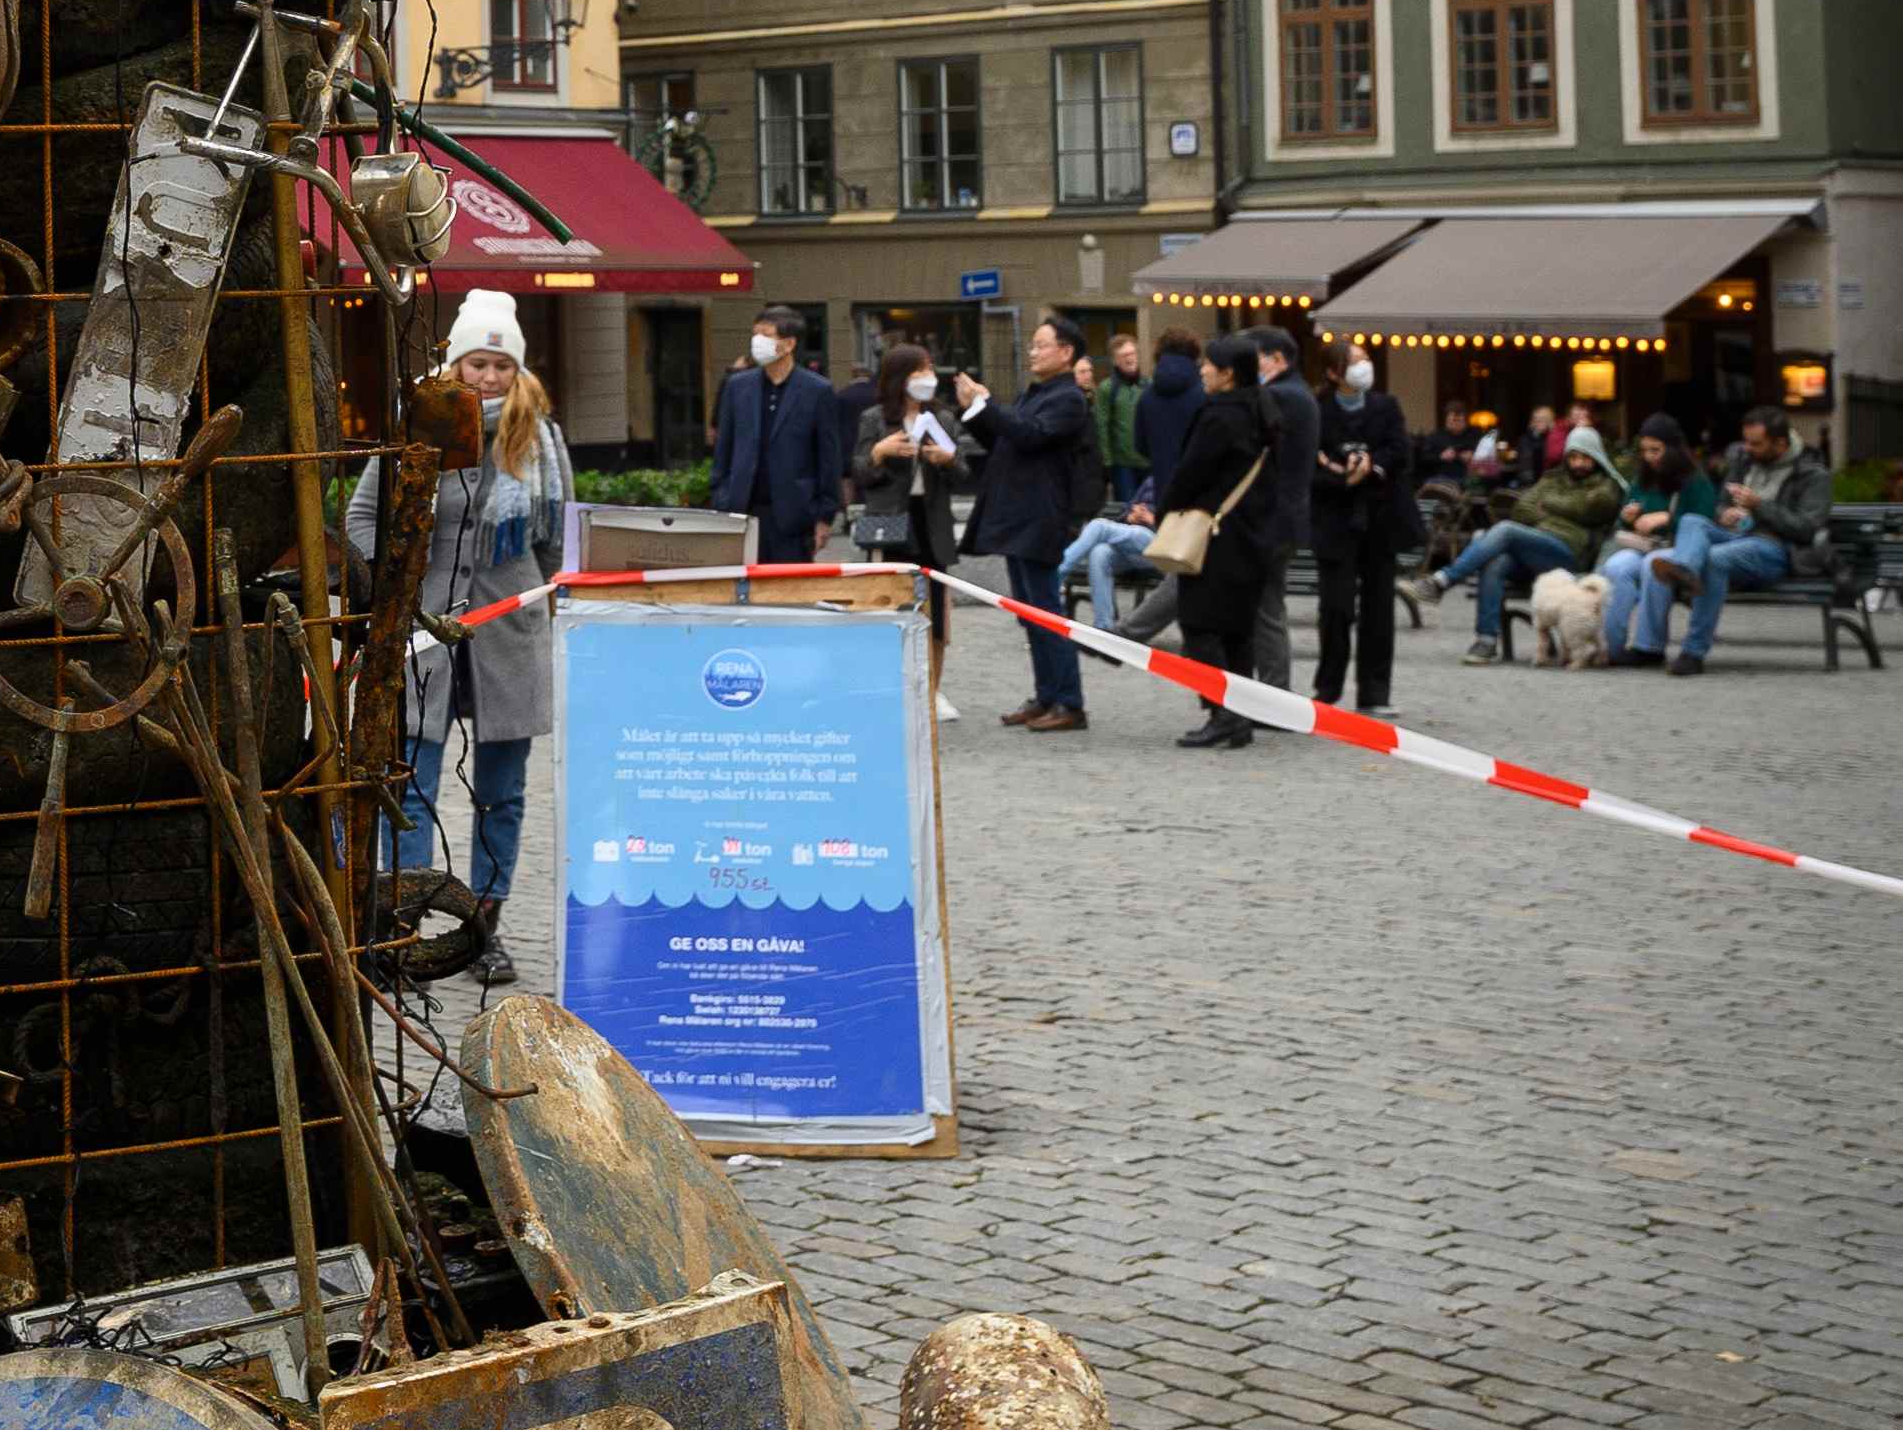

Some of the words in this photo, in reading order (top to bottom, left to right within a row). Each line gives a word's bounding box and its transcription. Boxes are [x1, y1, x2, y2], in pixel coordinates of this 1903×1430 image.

[715, 662, 755, 675] RENA
[648, 841, 675, 854] ton
[745, 843, 772, 856] ton
[861, 845, 888, 858] ton
[709, 867, 749, 889] 955
[669, 937, 693, 951] GE
[695, 937, 728, 951] OSS
[731, 938, 754, 952] EN
[756, 936, 805, 953] GÅVA!
